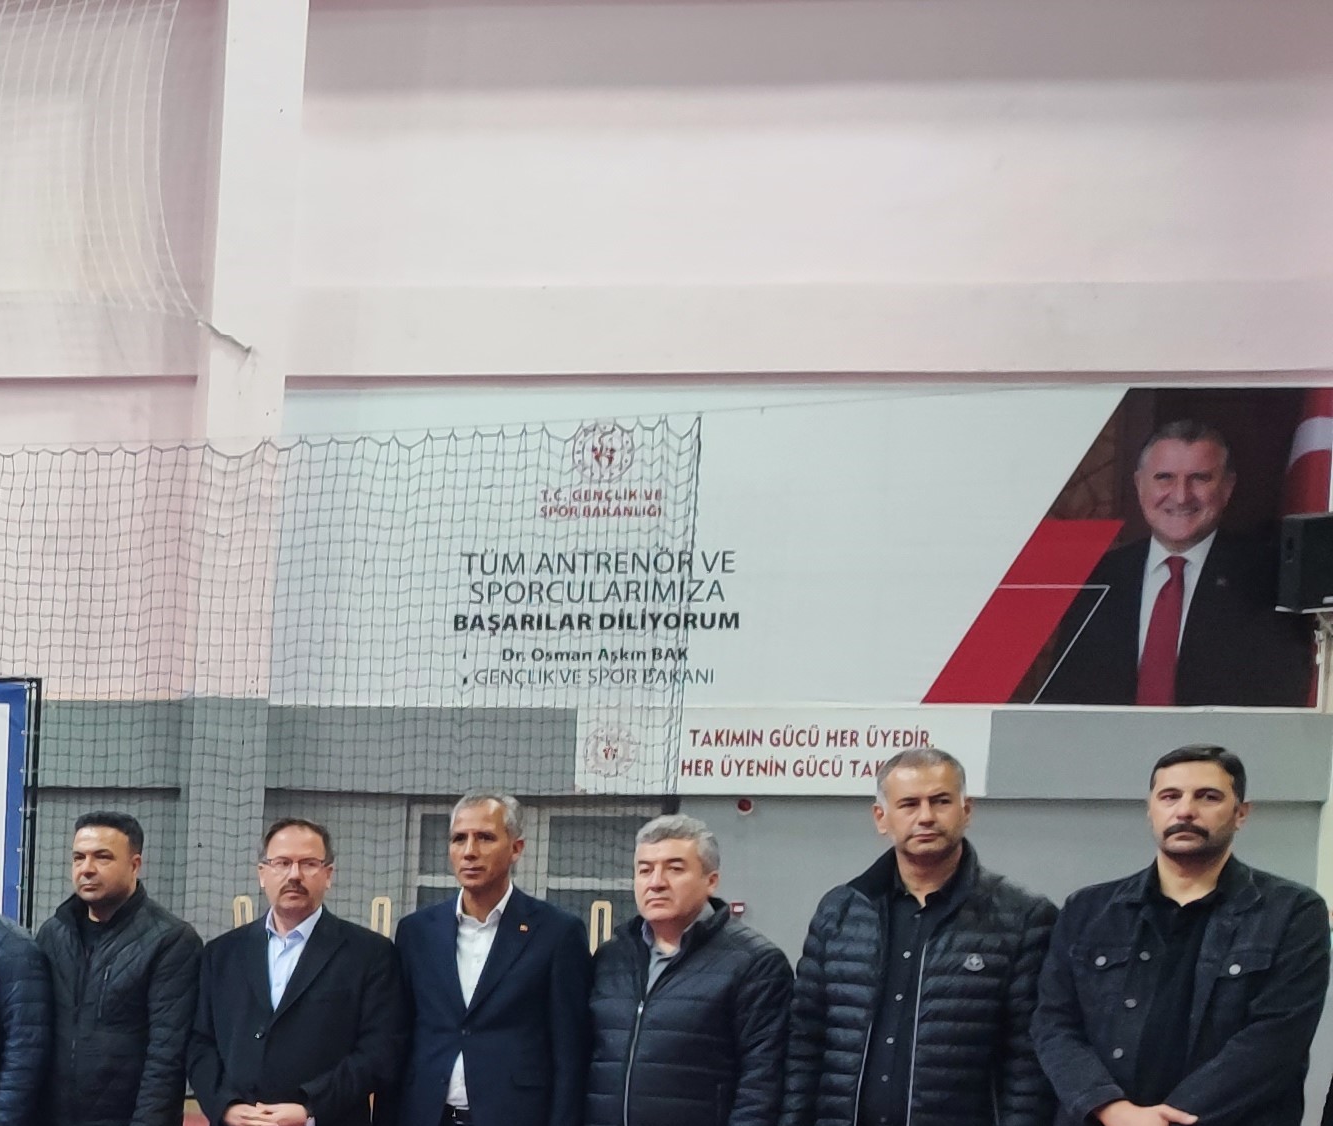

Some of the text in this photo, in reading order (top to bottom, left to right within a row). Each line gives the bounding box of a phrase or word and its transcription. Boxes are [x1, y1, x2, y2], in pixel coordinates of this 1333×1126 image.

[461, 547, 736, 576] TÜM ANTRENÖR VE
[470, 579, 725, 604] SPORCULARIMIZA
[453, 608, 740, 637] BAŞARILAR DİLİYORUM
[532, 648, 592, 662] Osman
[597, 648, 646, 665] Aşkın
[652, 647, 689, 662] BAK
[474, 668, 714, 689] GENÇLİK VE SPOR BAKANI
[690, 728, 763, 747] TAKIMIN
[769, 724, 820, 747] GÜCÜ
[826, 729, 859, 748] HER
[681, 754, 885, 777] HER ÜYENİN GÜCÜ TAK
